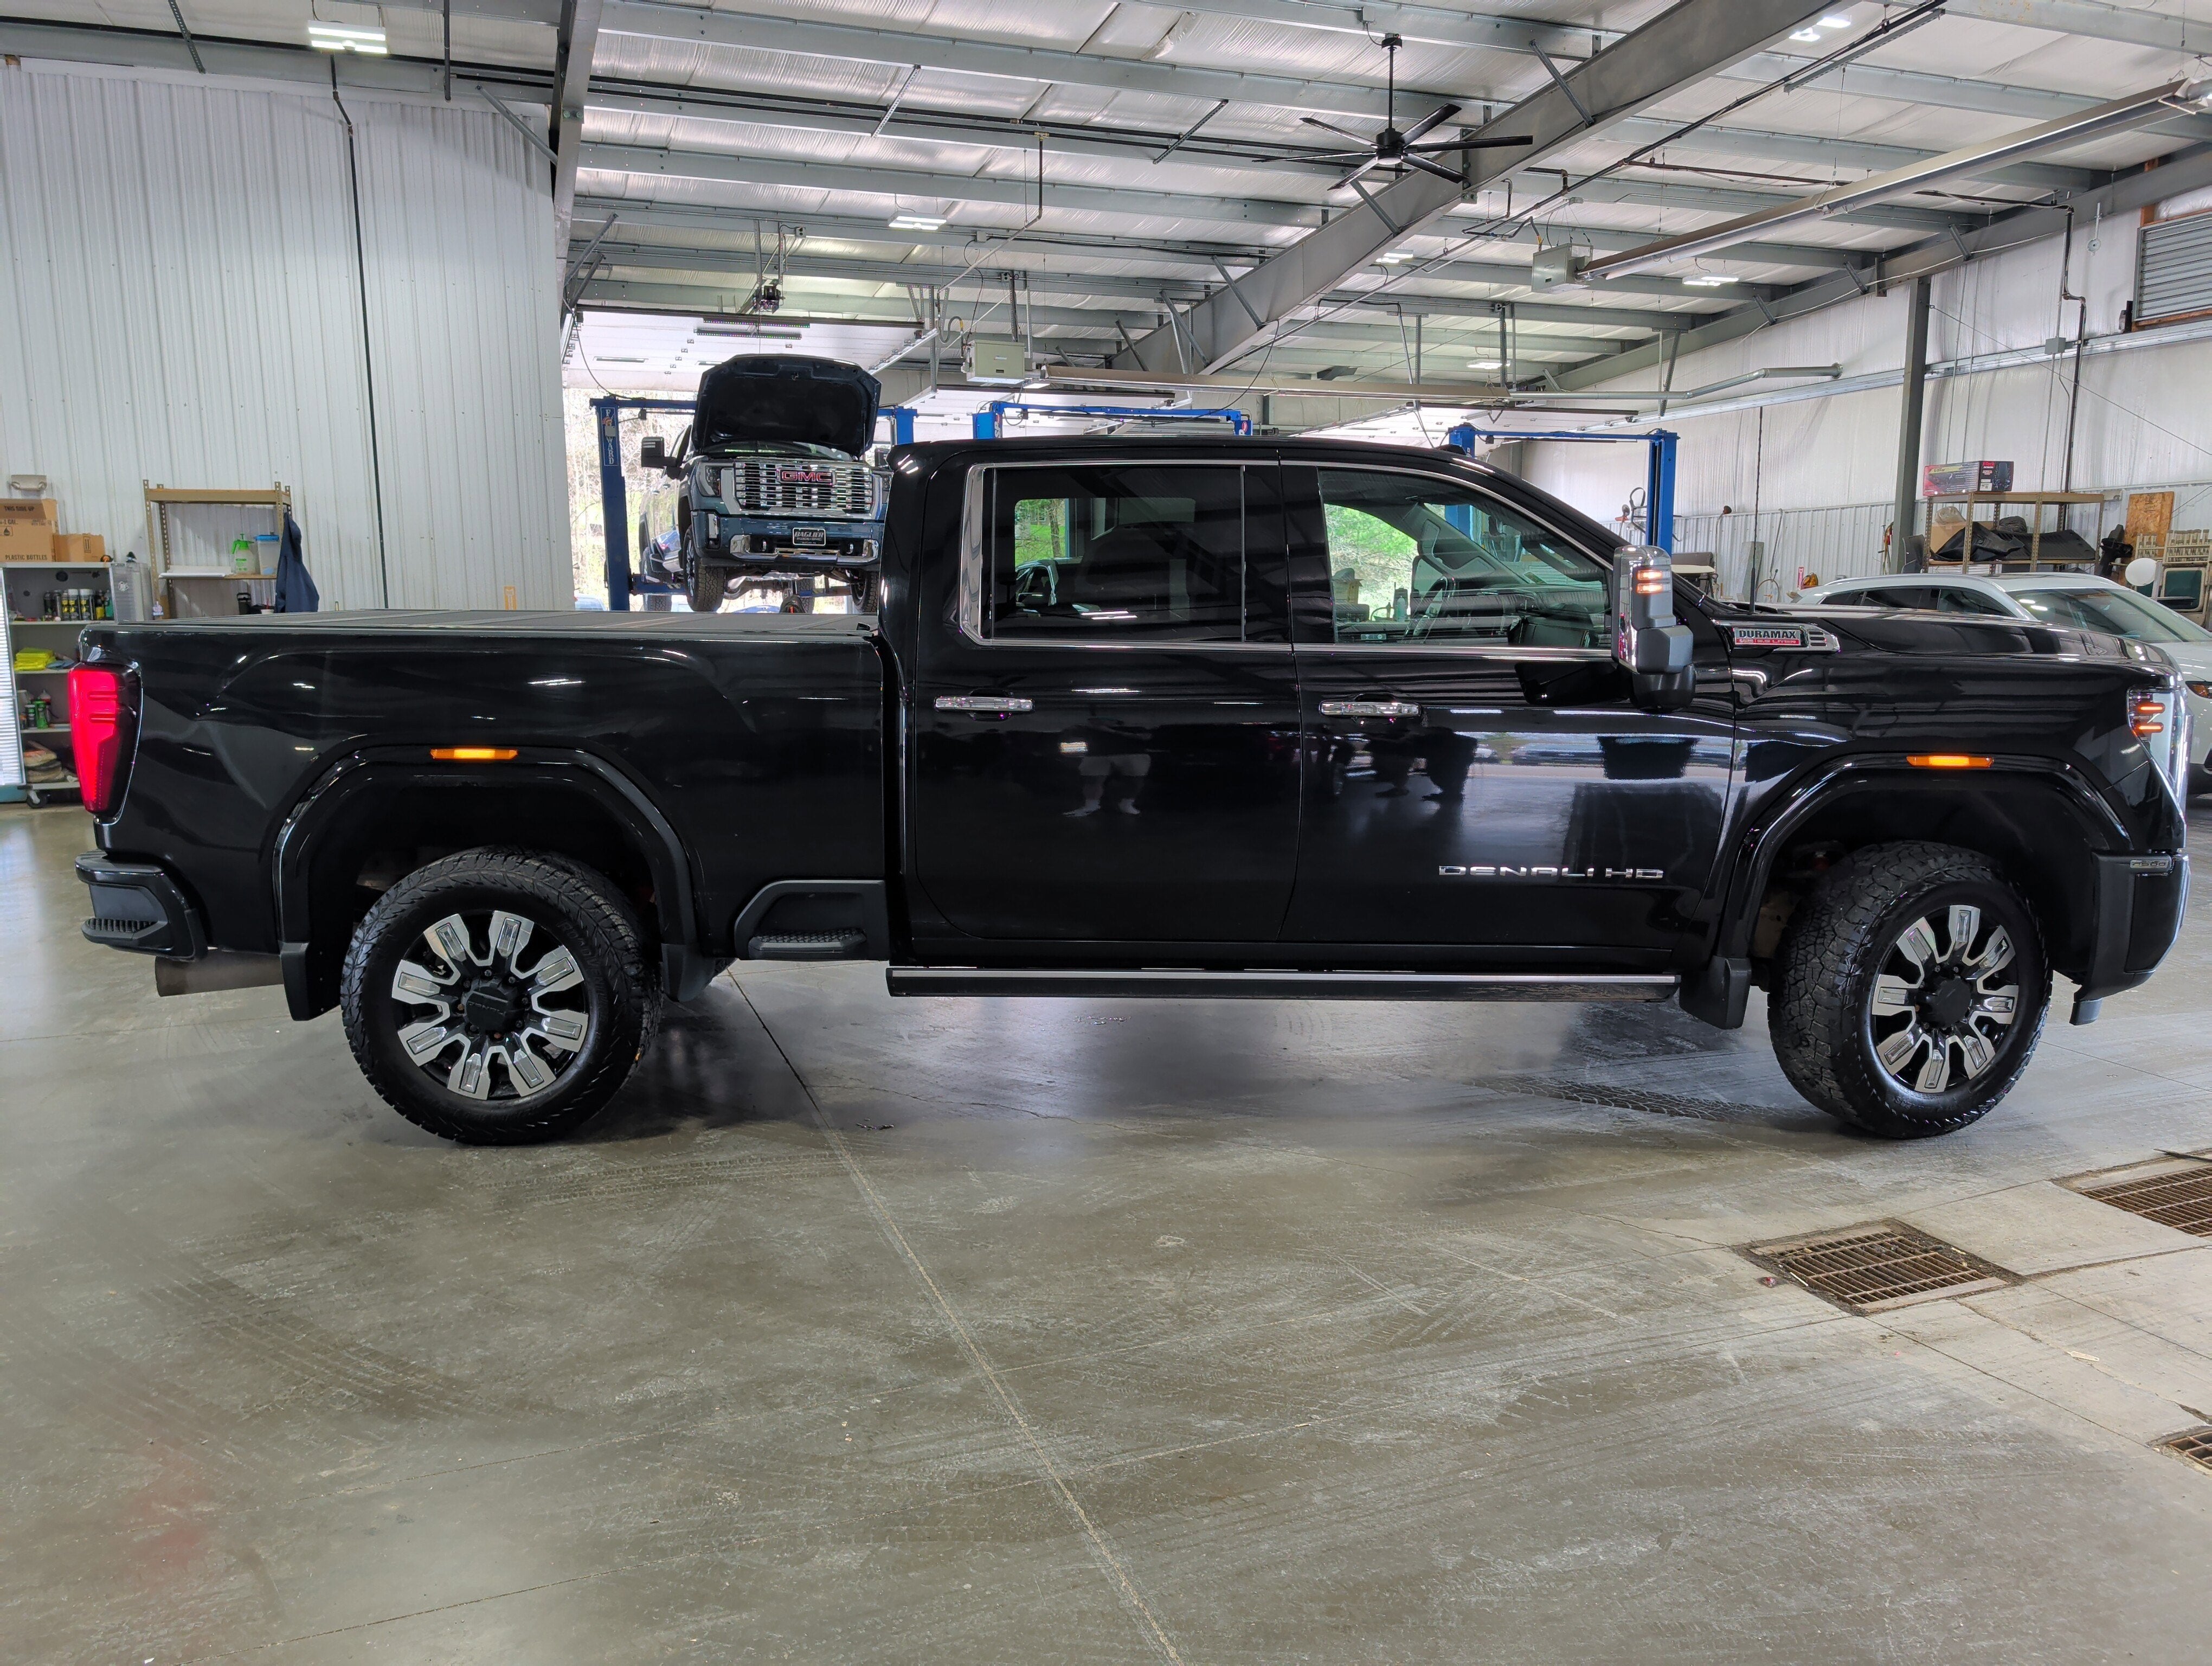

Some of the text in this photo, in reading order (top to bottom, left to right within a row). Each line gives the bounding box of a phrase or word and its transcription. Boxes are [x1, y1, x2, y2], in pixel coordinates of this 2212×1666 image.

[605, 409, 614, 464] FWARD
[782, 471, 832, 483] GMC
[1739, 630, 1797, 639] DURAMAX
[1438, 866, 1664, 879] DENALI HD
